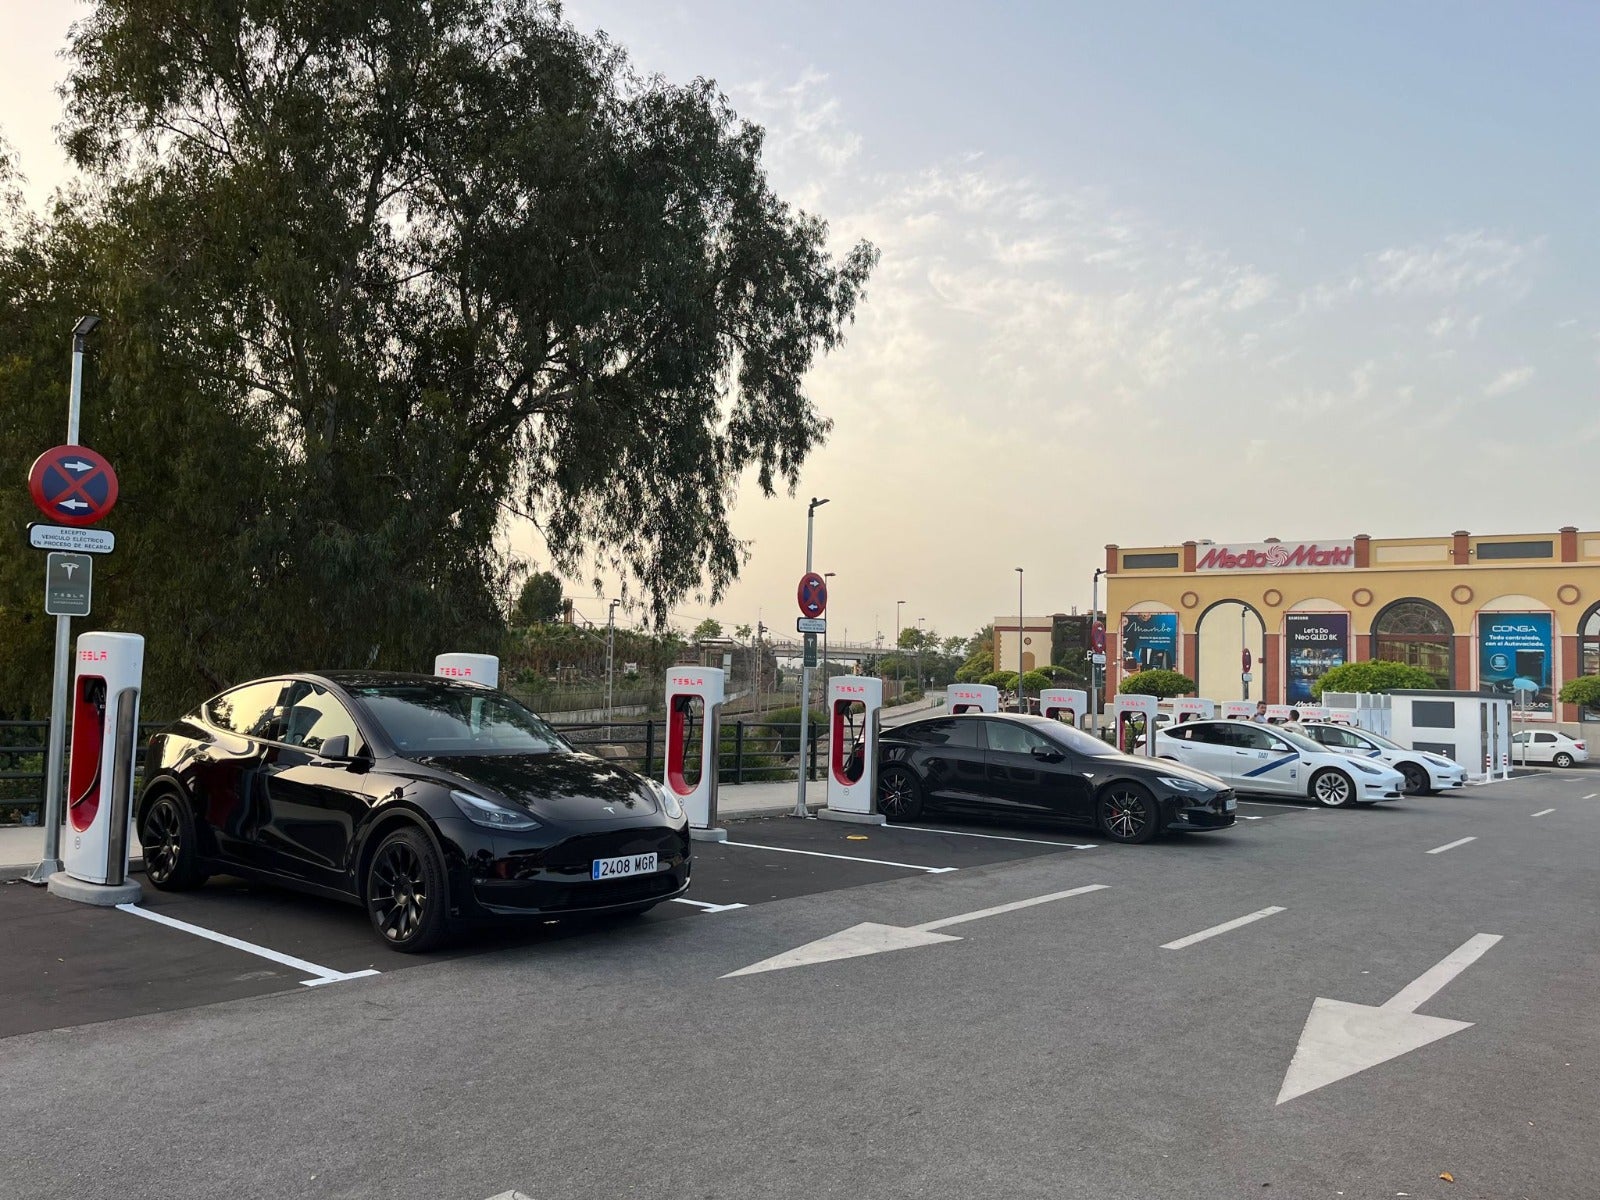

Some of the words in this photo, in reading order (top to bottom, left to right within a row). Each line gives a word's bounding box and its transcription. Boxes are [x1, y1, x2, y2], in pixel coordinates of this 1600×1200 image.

[1196, 548, 1268, 568] Media
[1283, 544, 1354, 566] Markt
[1126, 622, 1172, 632] Mambo
[79, 651, 107, 661] TESLA
[440, 668, 472, 676] TESLA
[602, 860, 630, 876] 2408
[635, 856, 654, 871] MGR
